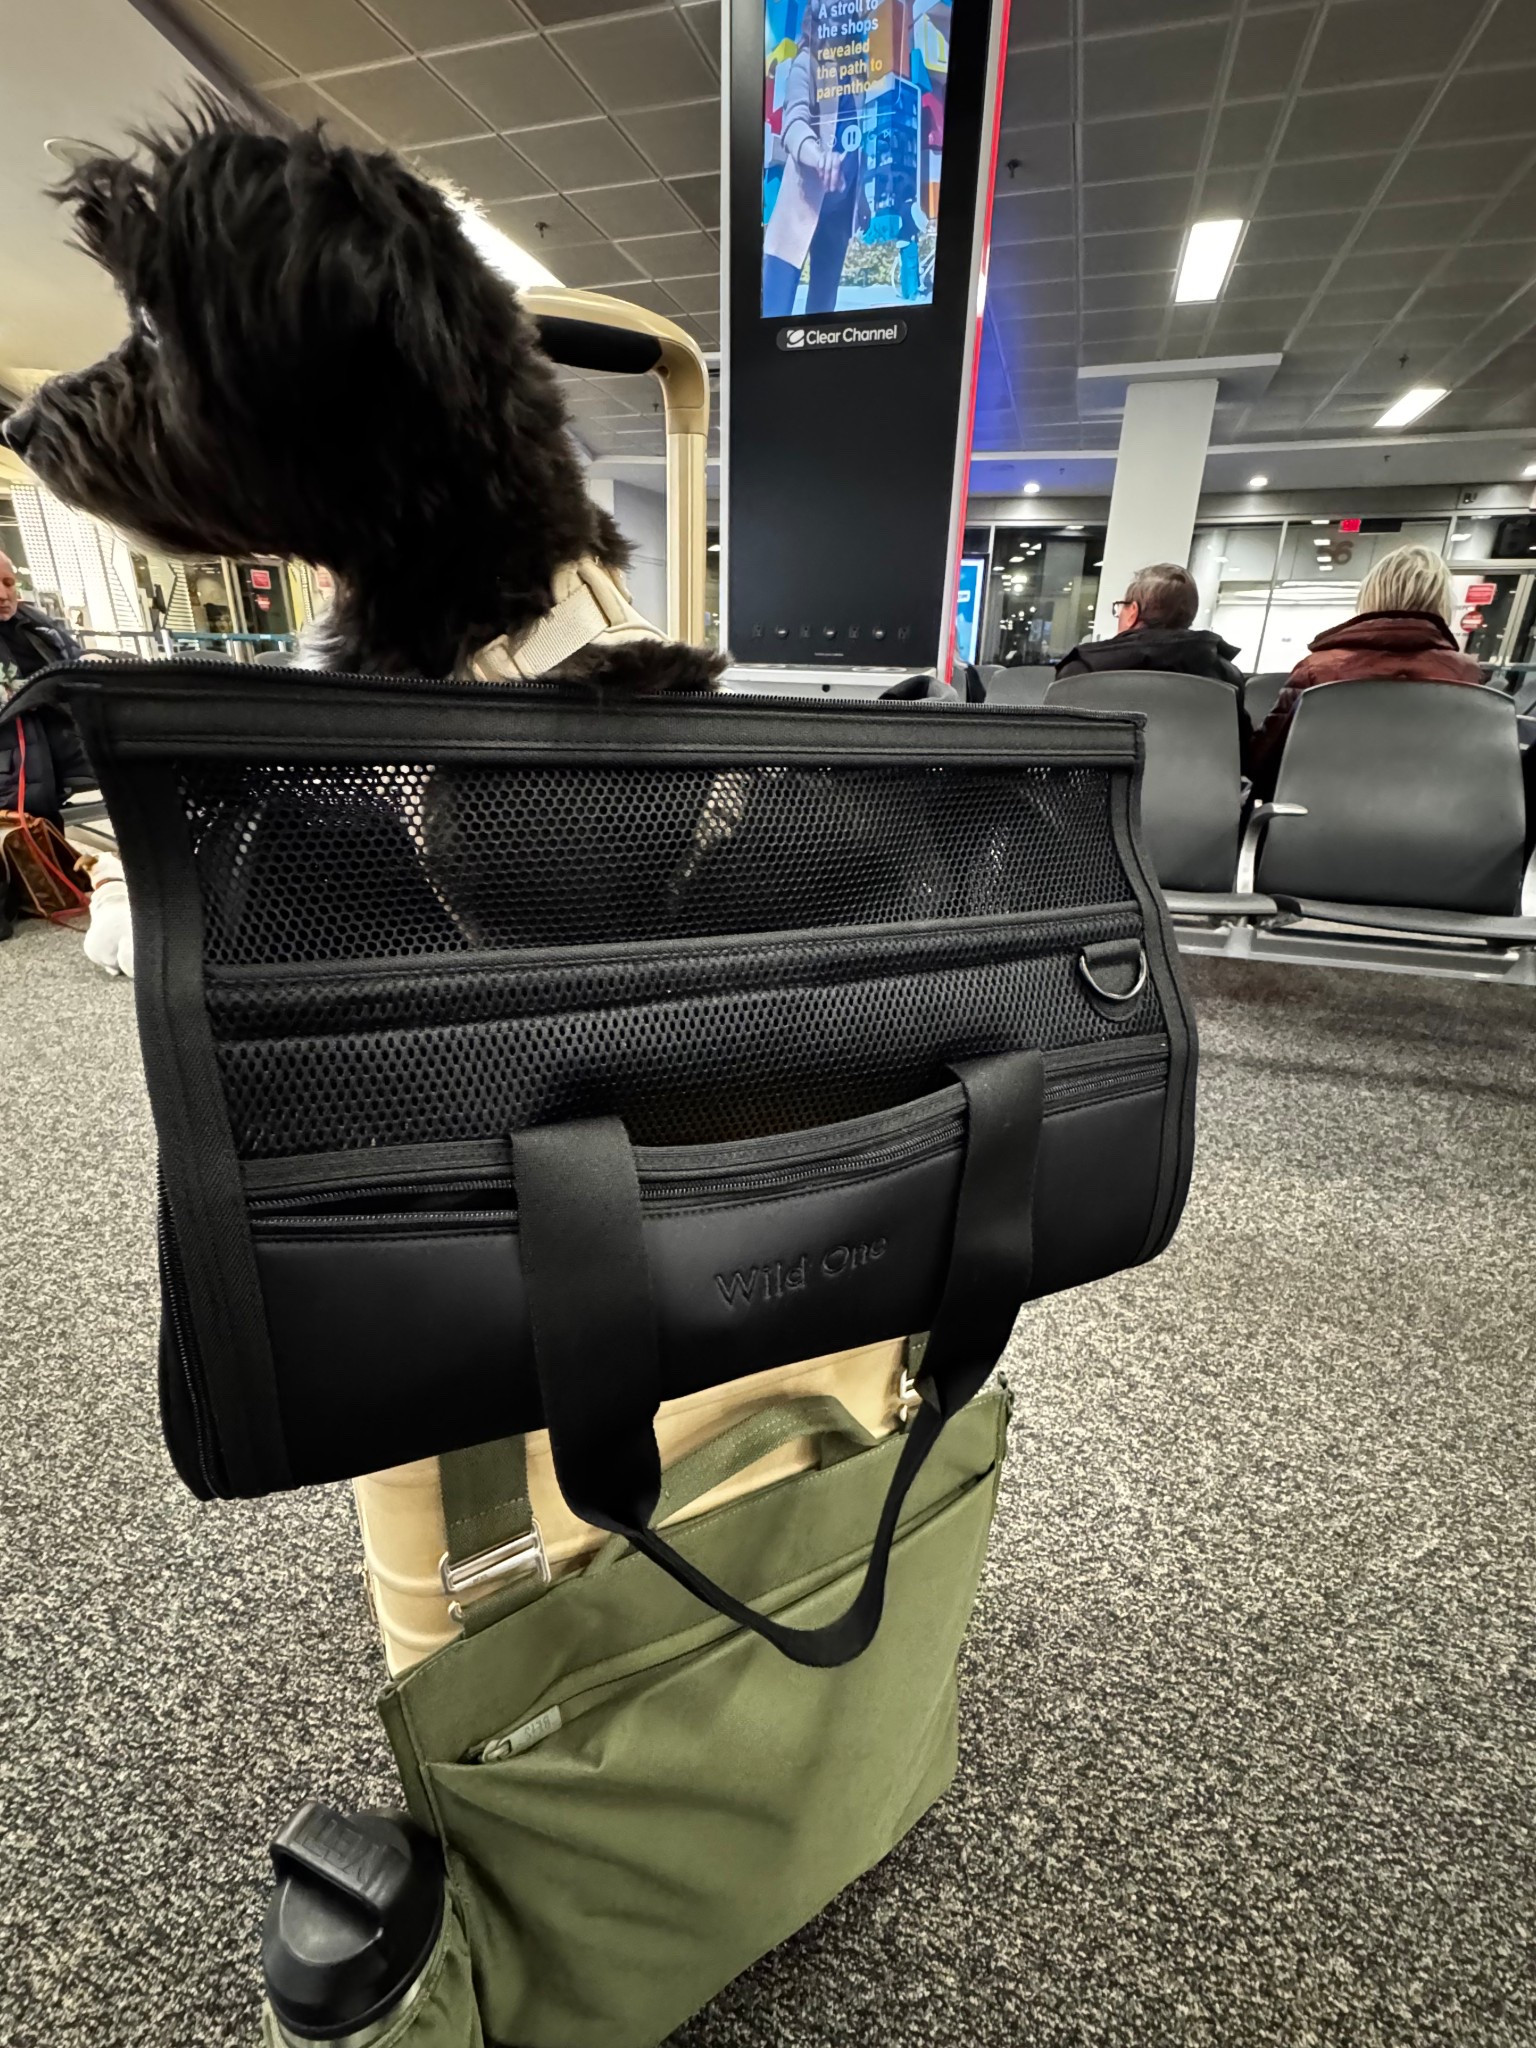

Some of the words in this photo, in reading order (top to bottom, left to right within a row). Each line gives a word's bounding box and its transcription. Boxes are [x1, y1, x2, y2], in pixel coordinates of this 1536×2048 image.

[818, 3, 828, 19] A
[830, 0, 863, 17] stroll
[866, 0, 878, 11] to
[817, 23, 838, 39] the
[840, 18, 879, 36] shops
[817, 39, 870, 60] revealed
[816, 65, 837, 80] the
[839, 59, 867, 80] path
[870, 58, 883, 72] to
[806, 330, 841, 345] Clear
[842, 324, 898, 342] Channel
[714, 1255, 806, 1312] Wild
[822, 1237, 887, 1277] One
[294, 1812, 381, 1885] YETI
